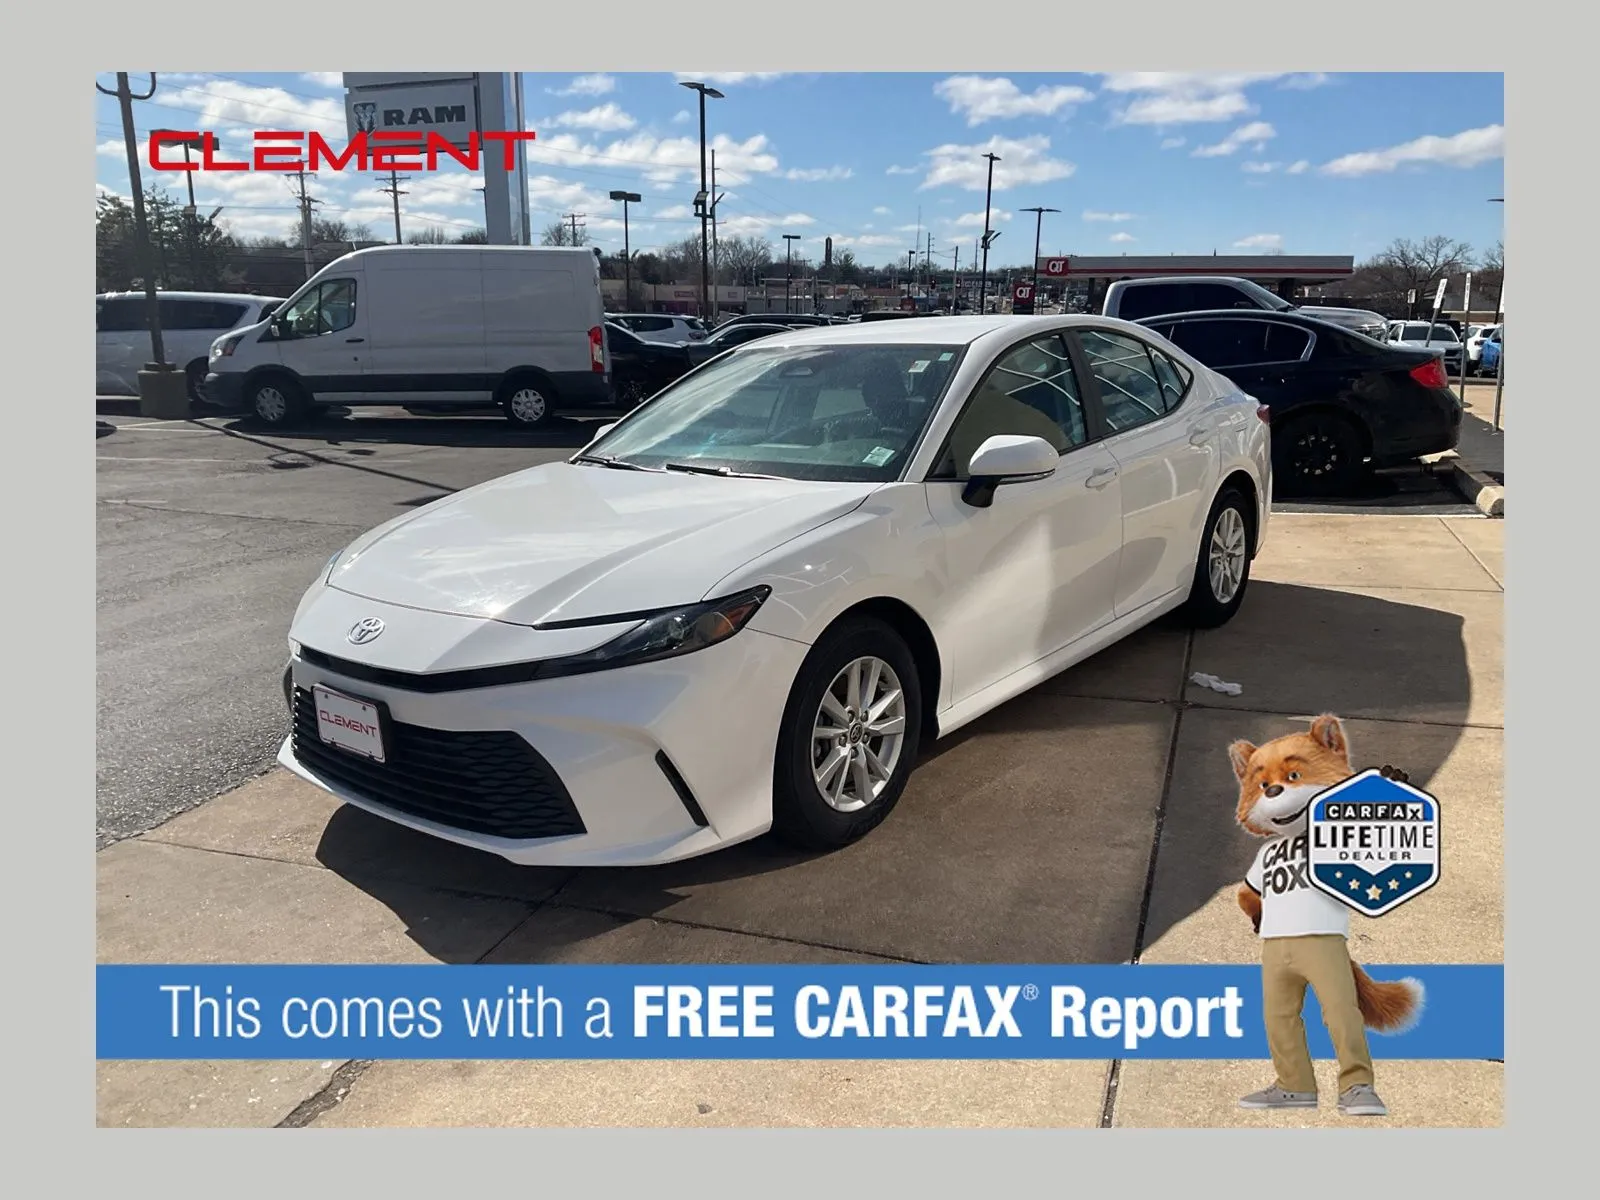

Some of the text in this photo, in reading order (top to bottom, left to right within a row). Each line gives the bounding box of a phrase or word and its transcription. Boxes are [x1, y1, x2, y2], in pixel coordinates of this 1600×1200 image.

[383, 105, 466, 126] RAM
[1048, 260, 1065, 273] QT
[1016, 286, 1032, 299] QT
[320, 709, 377, 737] CLEMENT
